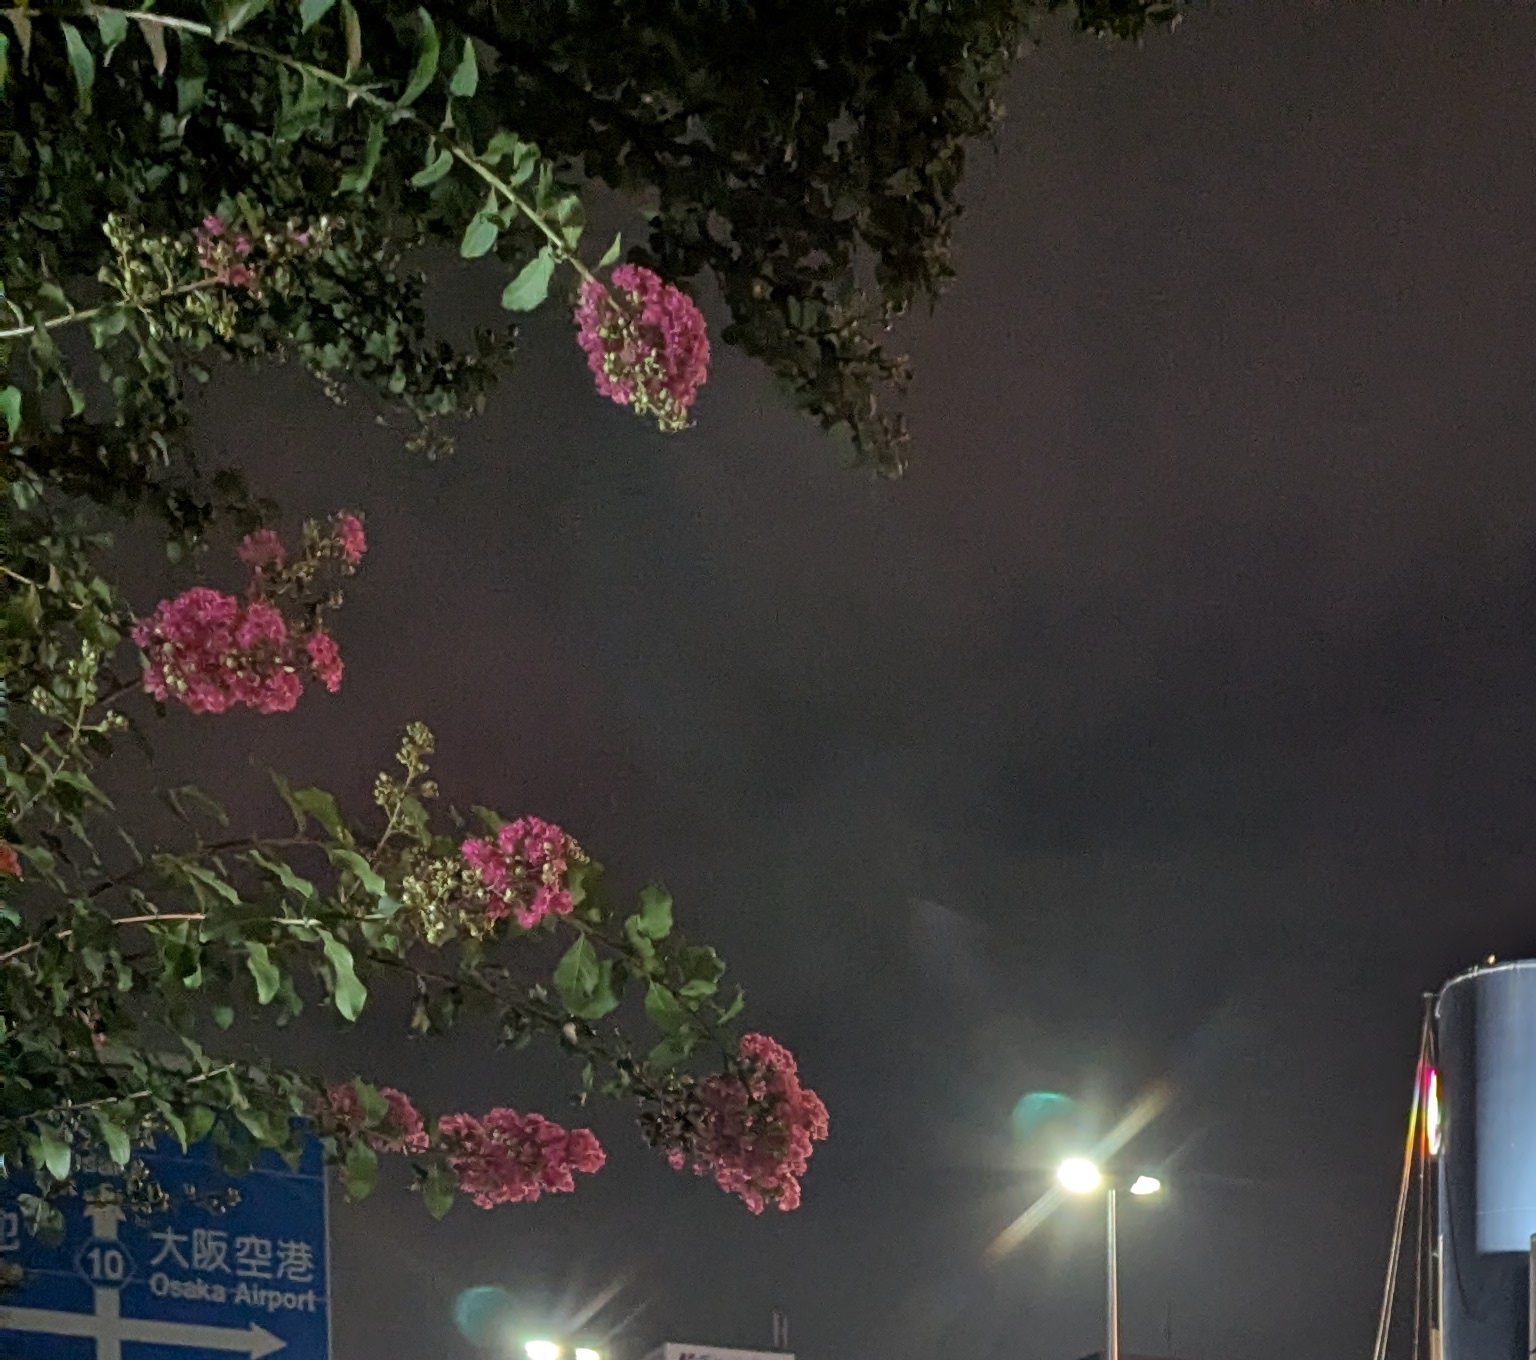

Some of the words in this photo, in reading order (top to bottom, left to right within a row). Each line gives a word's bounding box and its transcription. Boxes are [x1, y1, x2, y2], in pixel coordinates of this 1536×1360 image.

[89, 1247, 125, 1281] 10
[150, 1225, 315, 1283] 大阪空港
[151, 1272, 227, 1303] Osaka
[233, 1281, 317, 1313] Airport
